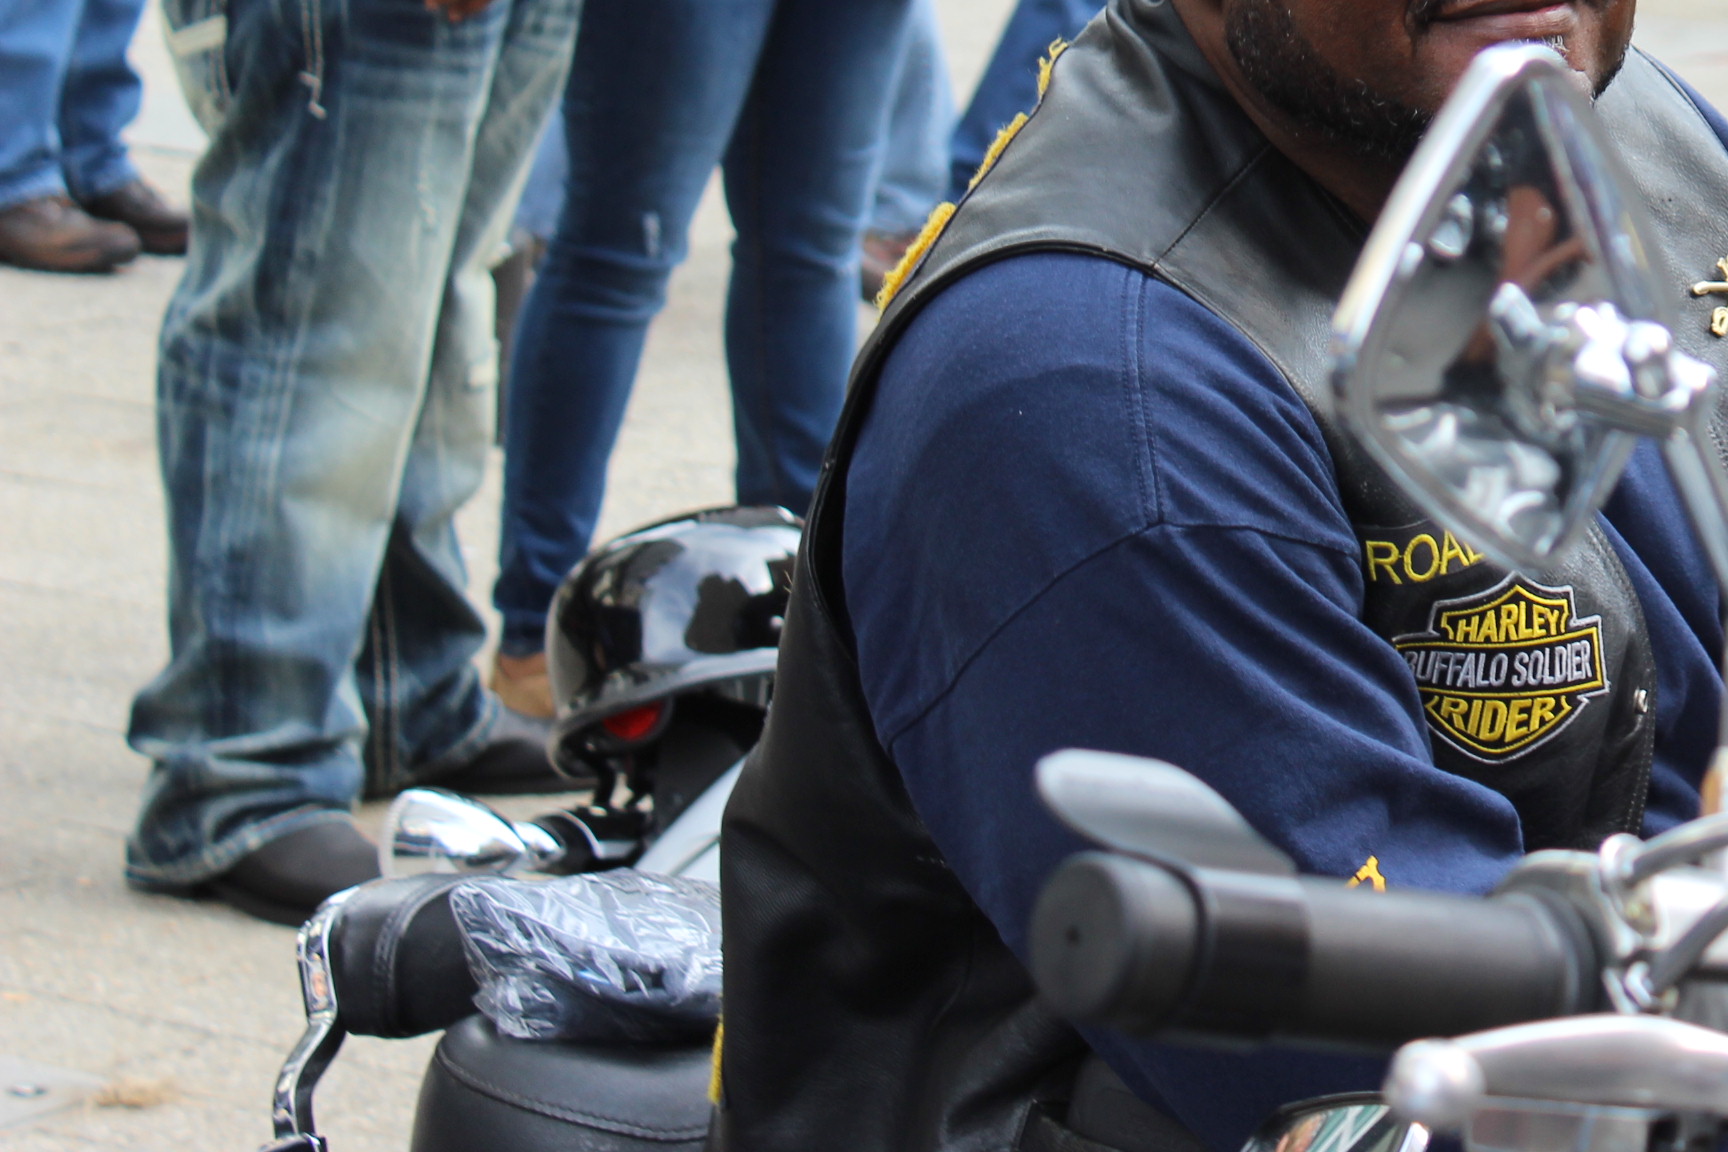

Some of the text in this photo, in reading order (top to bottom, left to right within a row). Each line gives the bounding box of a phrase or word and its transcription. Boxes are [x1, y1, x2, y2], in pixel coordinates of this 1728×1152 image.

[1455, 600, 1560, 643] HARLEY
[1404, 639, 1593, 689] BUFFALO SOLDIER
[1438, 696, 1556, 744] RIDER
